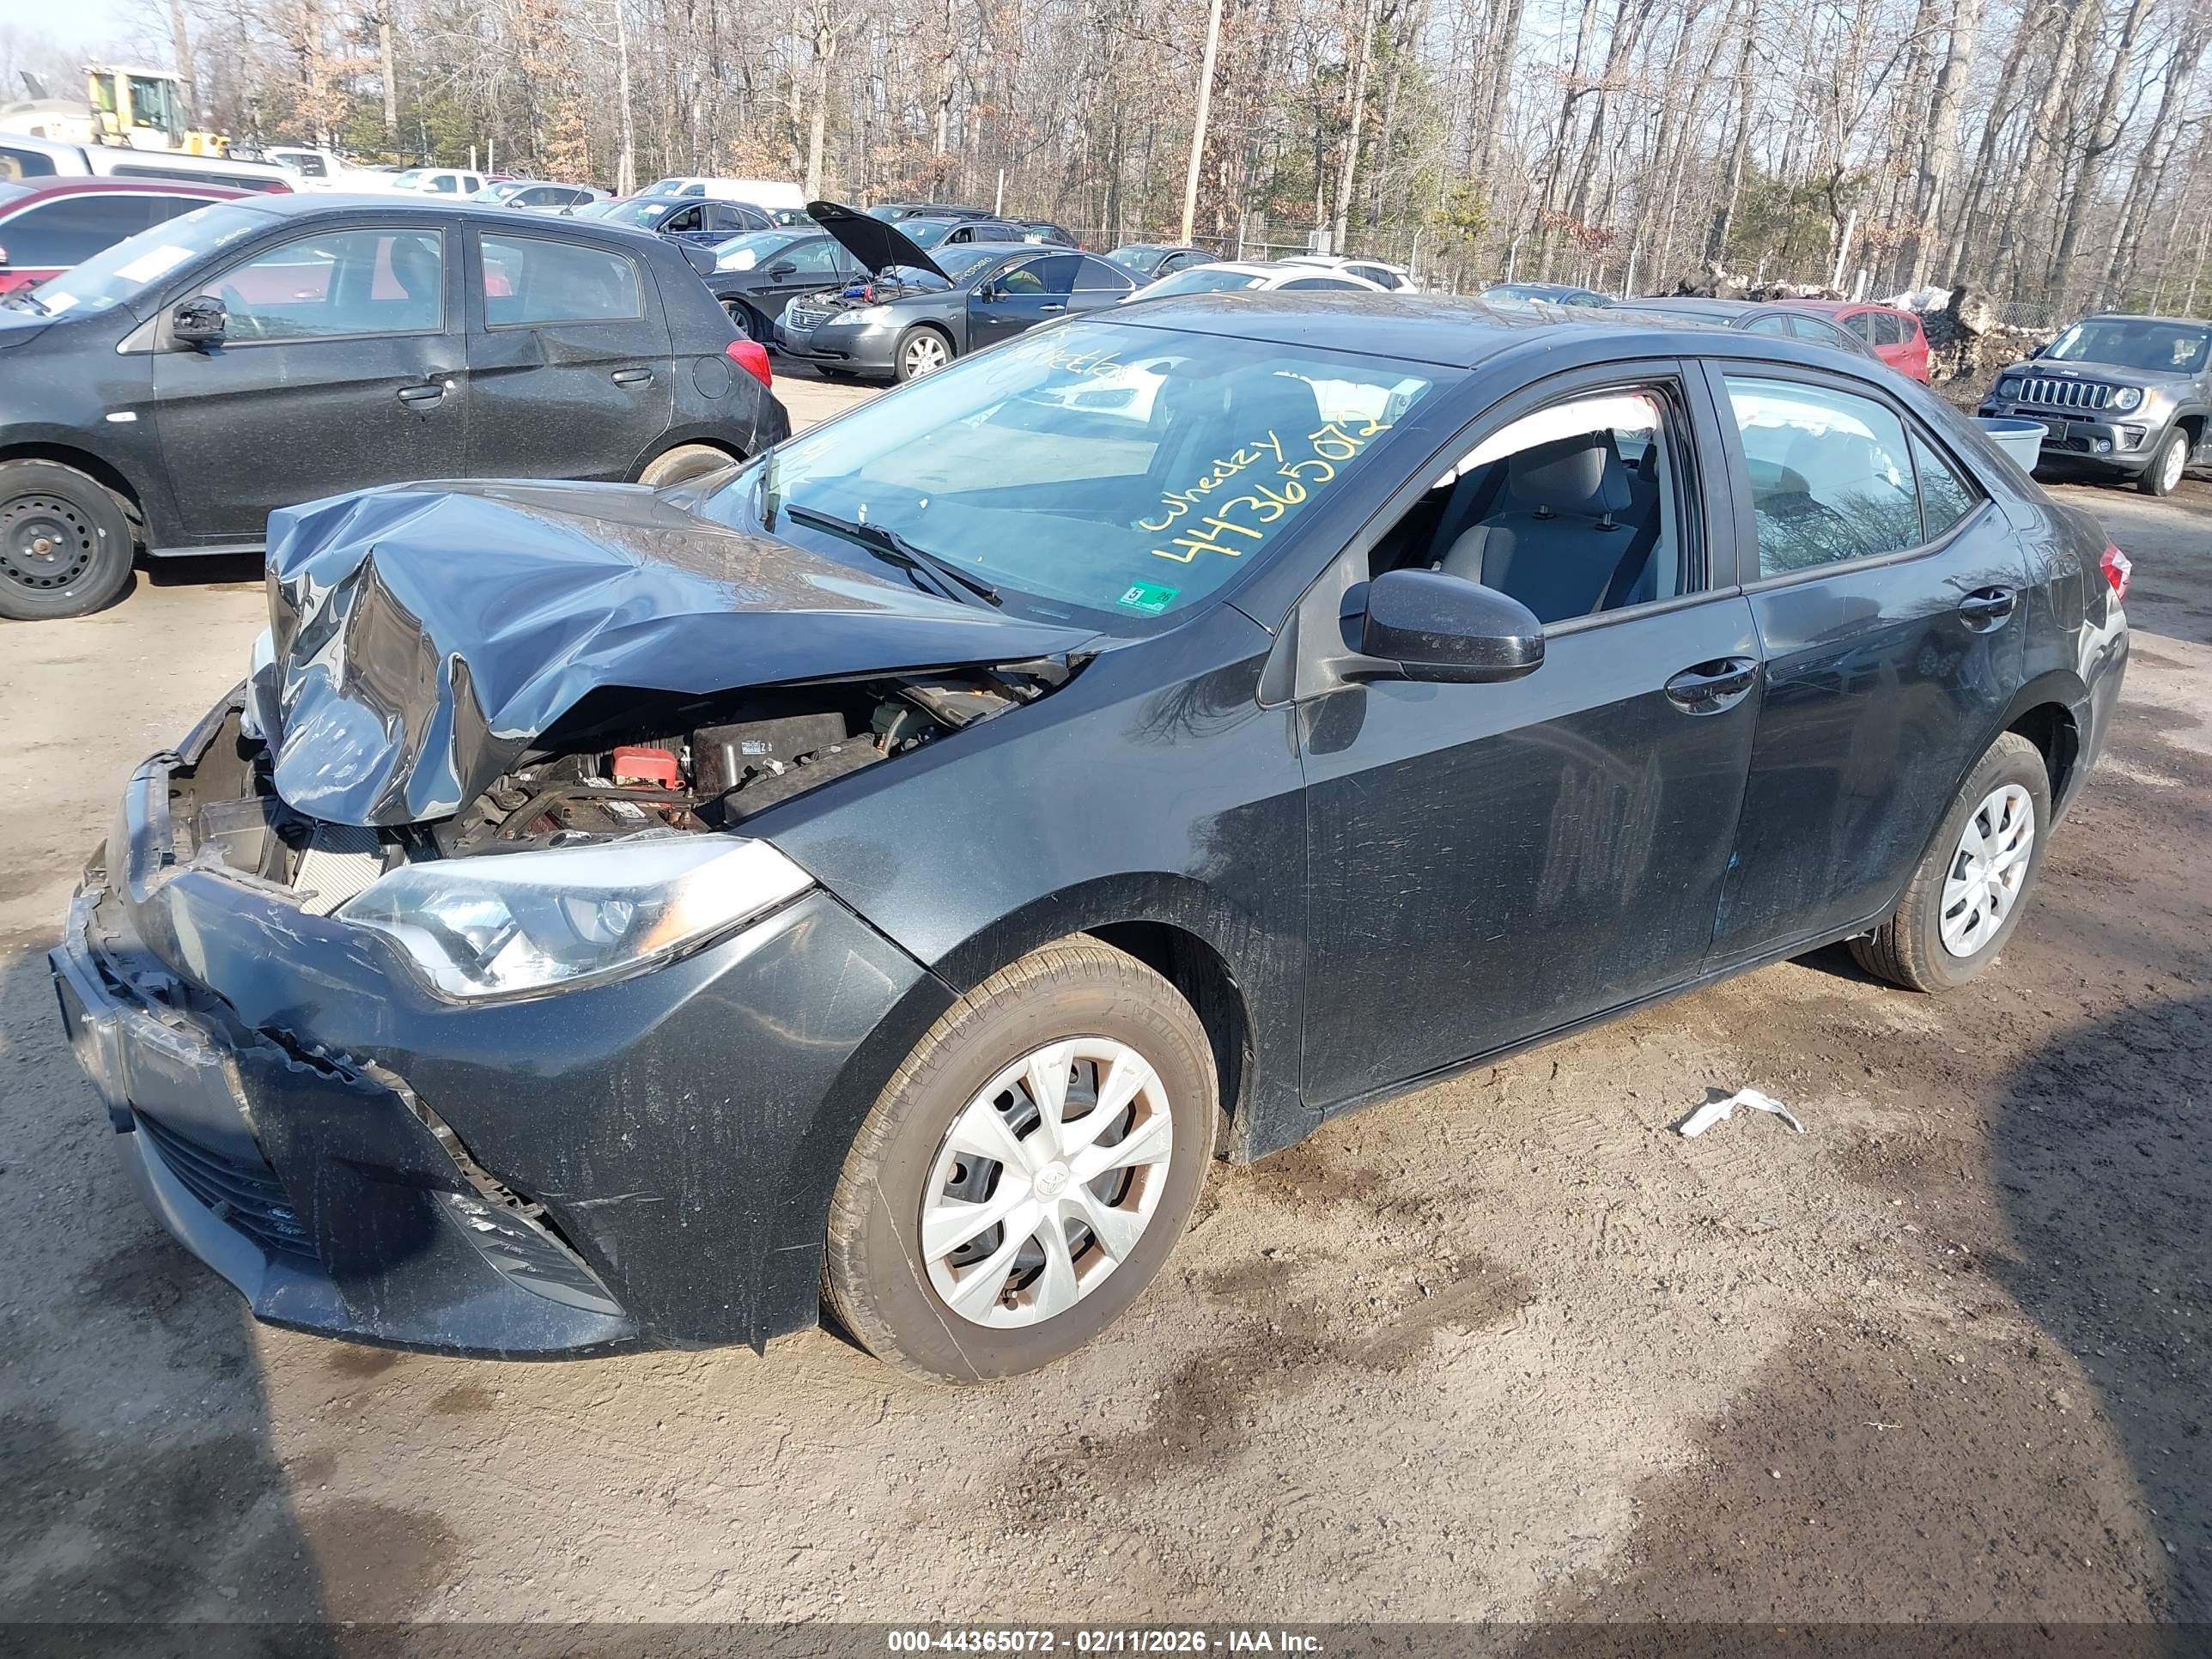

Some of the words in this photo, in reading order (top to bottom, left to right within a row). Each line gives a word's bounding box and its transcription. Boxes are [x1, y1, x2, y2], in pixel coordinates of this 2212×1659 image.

[1152, 410, 1394, 563] 44365072
[1128, 588, 1142, 599] 5
[1156, 592, 1173, 602] 26
